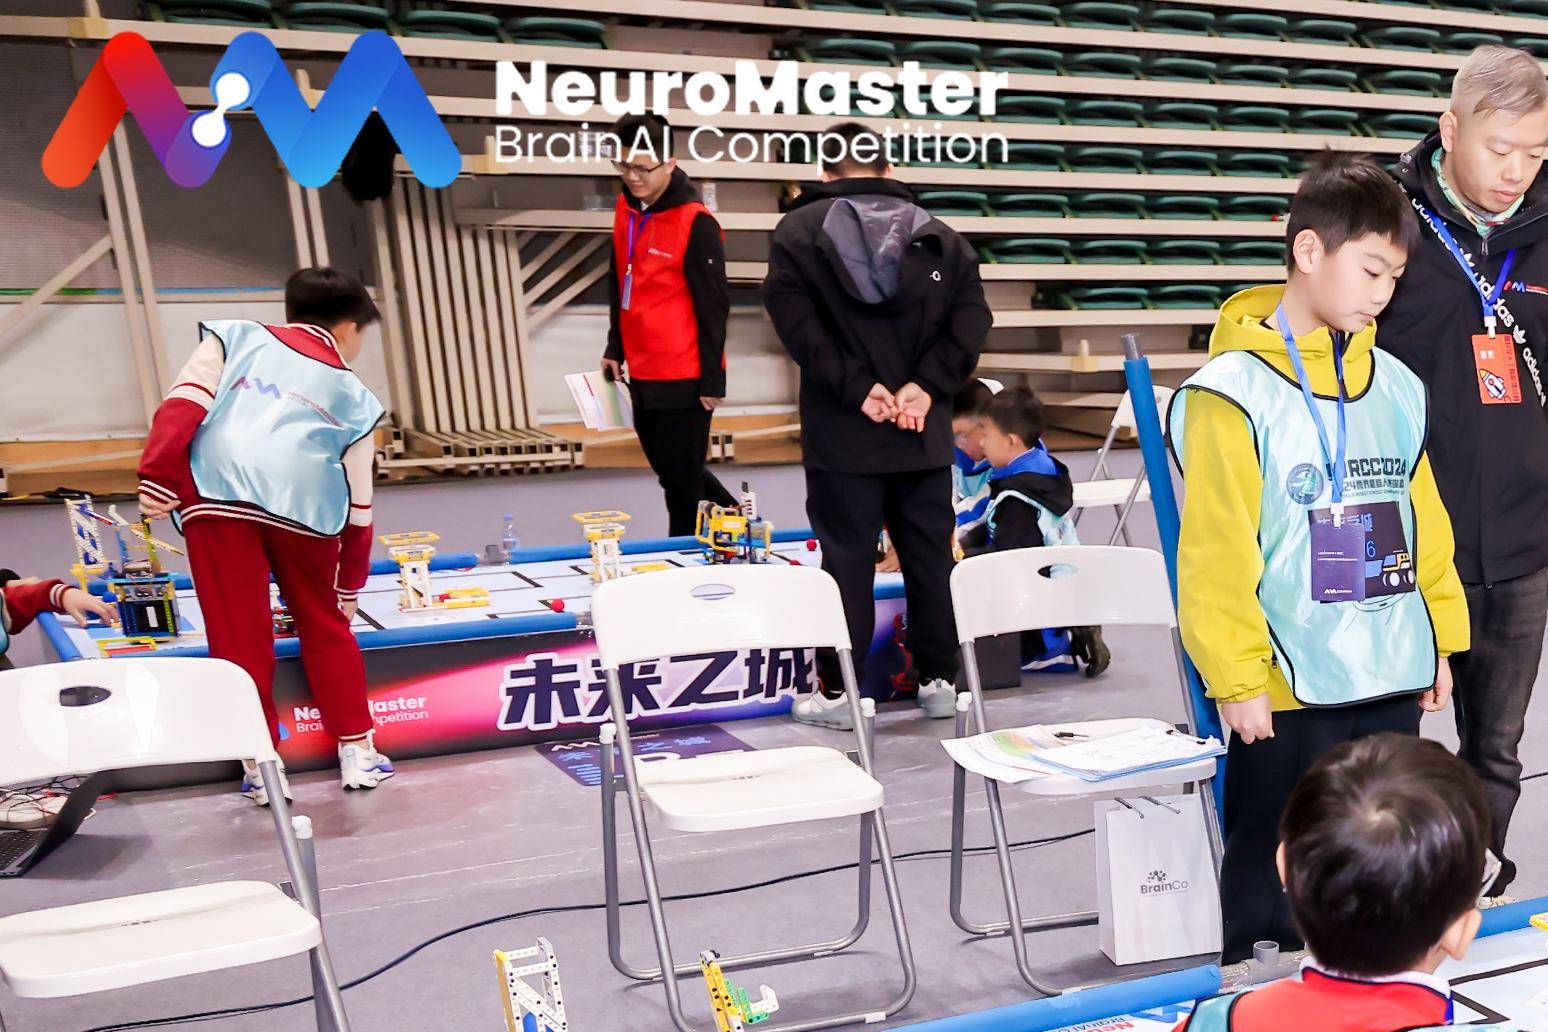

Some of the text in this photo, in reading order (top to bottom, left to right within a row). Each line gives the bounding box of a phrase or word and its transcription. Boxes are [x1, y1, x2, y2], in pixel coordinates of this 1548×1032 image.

[294, 696, 426, 721] Neaster
[373, 710, 429, 726] petition
[1140, 881, 1188, 894] BrainCo
